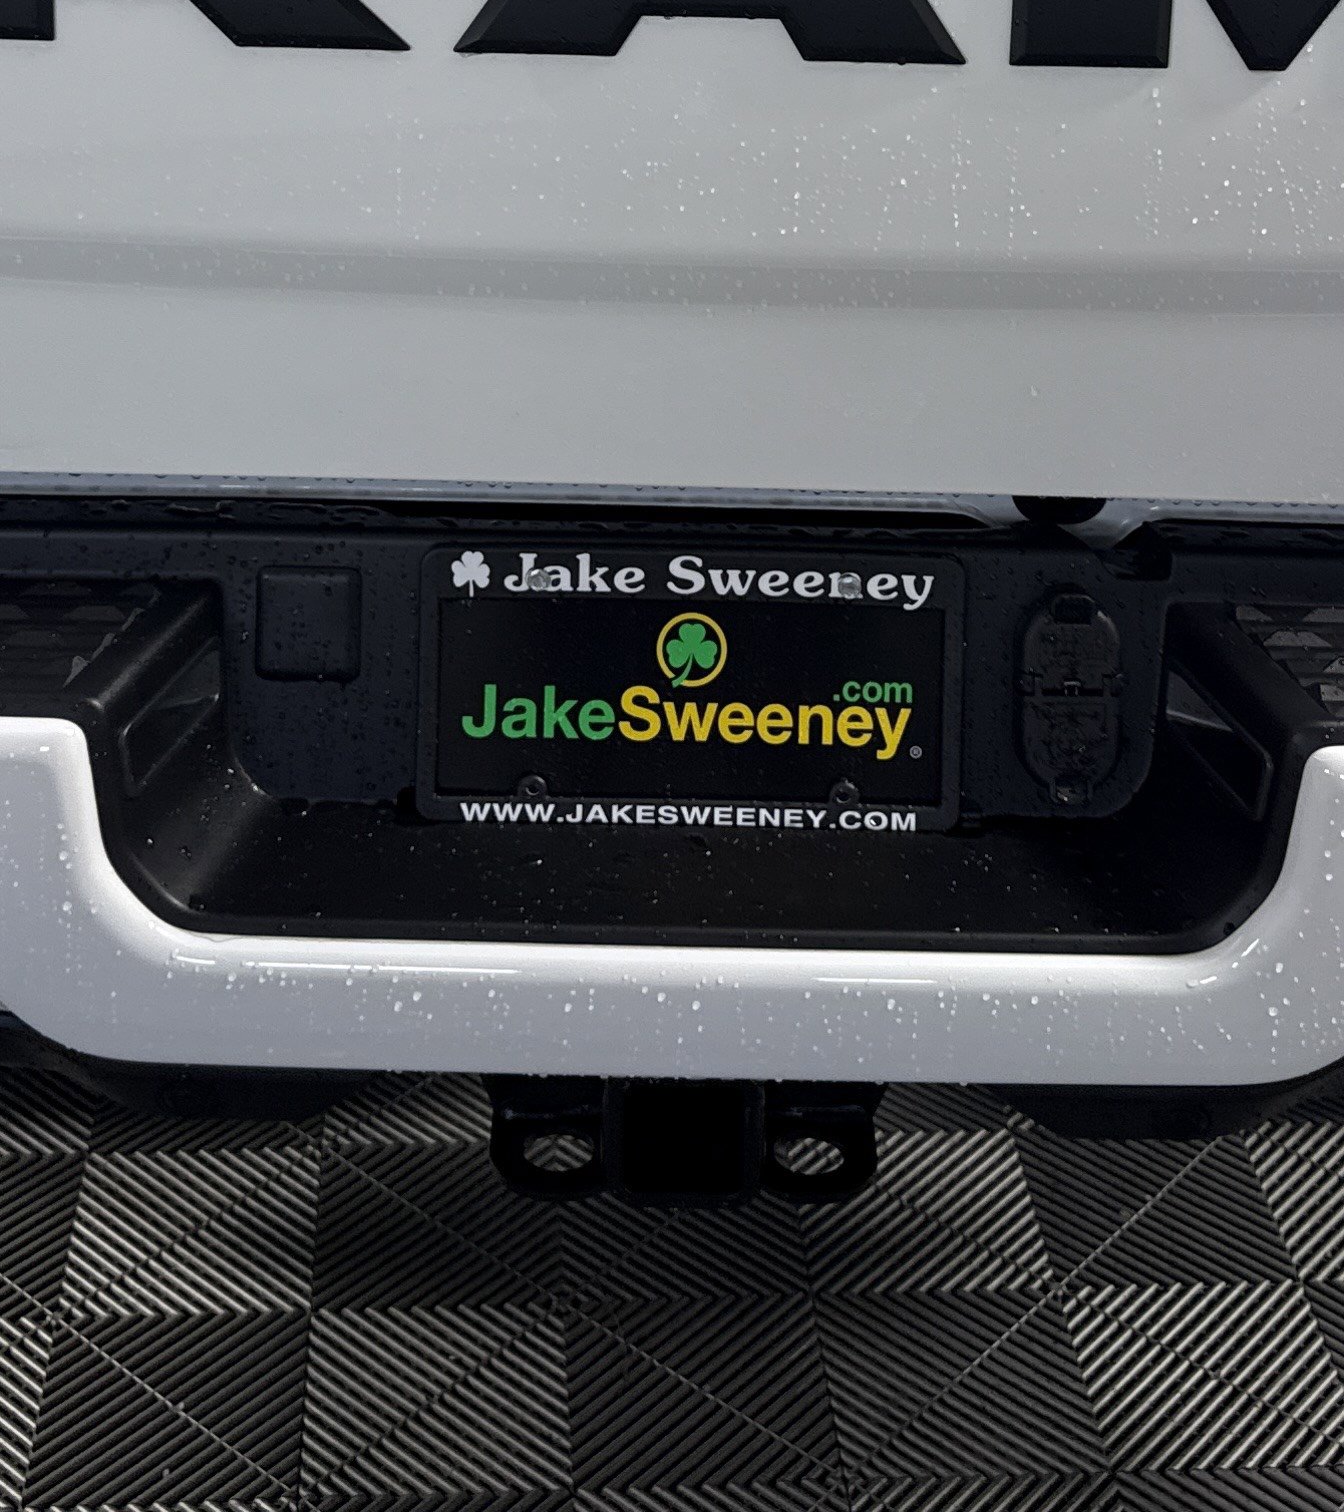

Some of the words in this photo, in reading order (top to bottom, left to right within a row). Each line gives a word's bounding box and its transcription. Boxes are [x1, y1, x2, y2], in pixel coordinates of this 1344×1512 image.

[504, 552, 645, 594] Jake
[666, 555, 934, 610] Sweeney
[459, 802, 917, 832] WWW.JAKESWEENEY.COM
